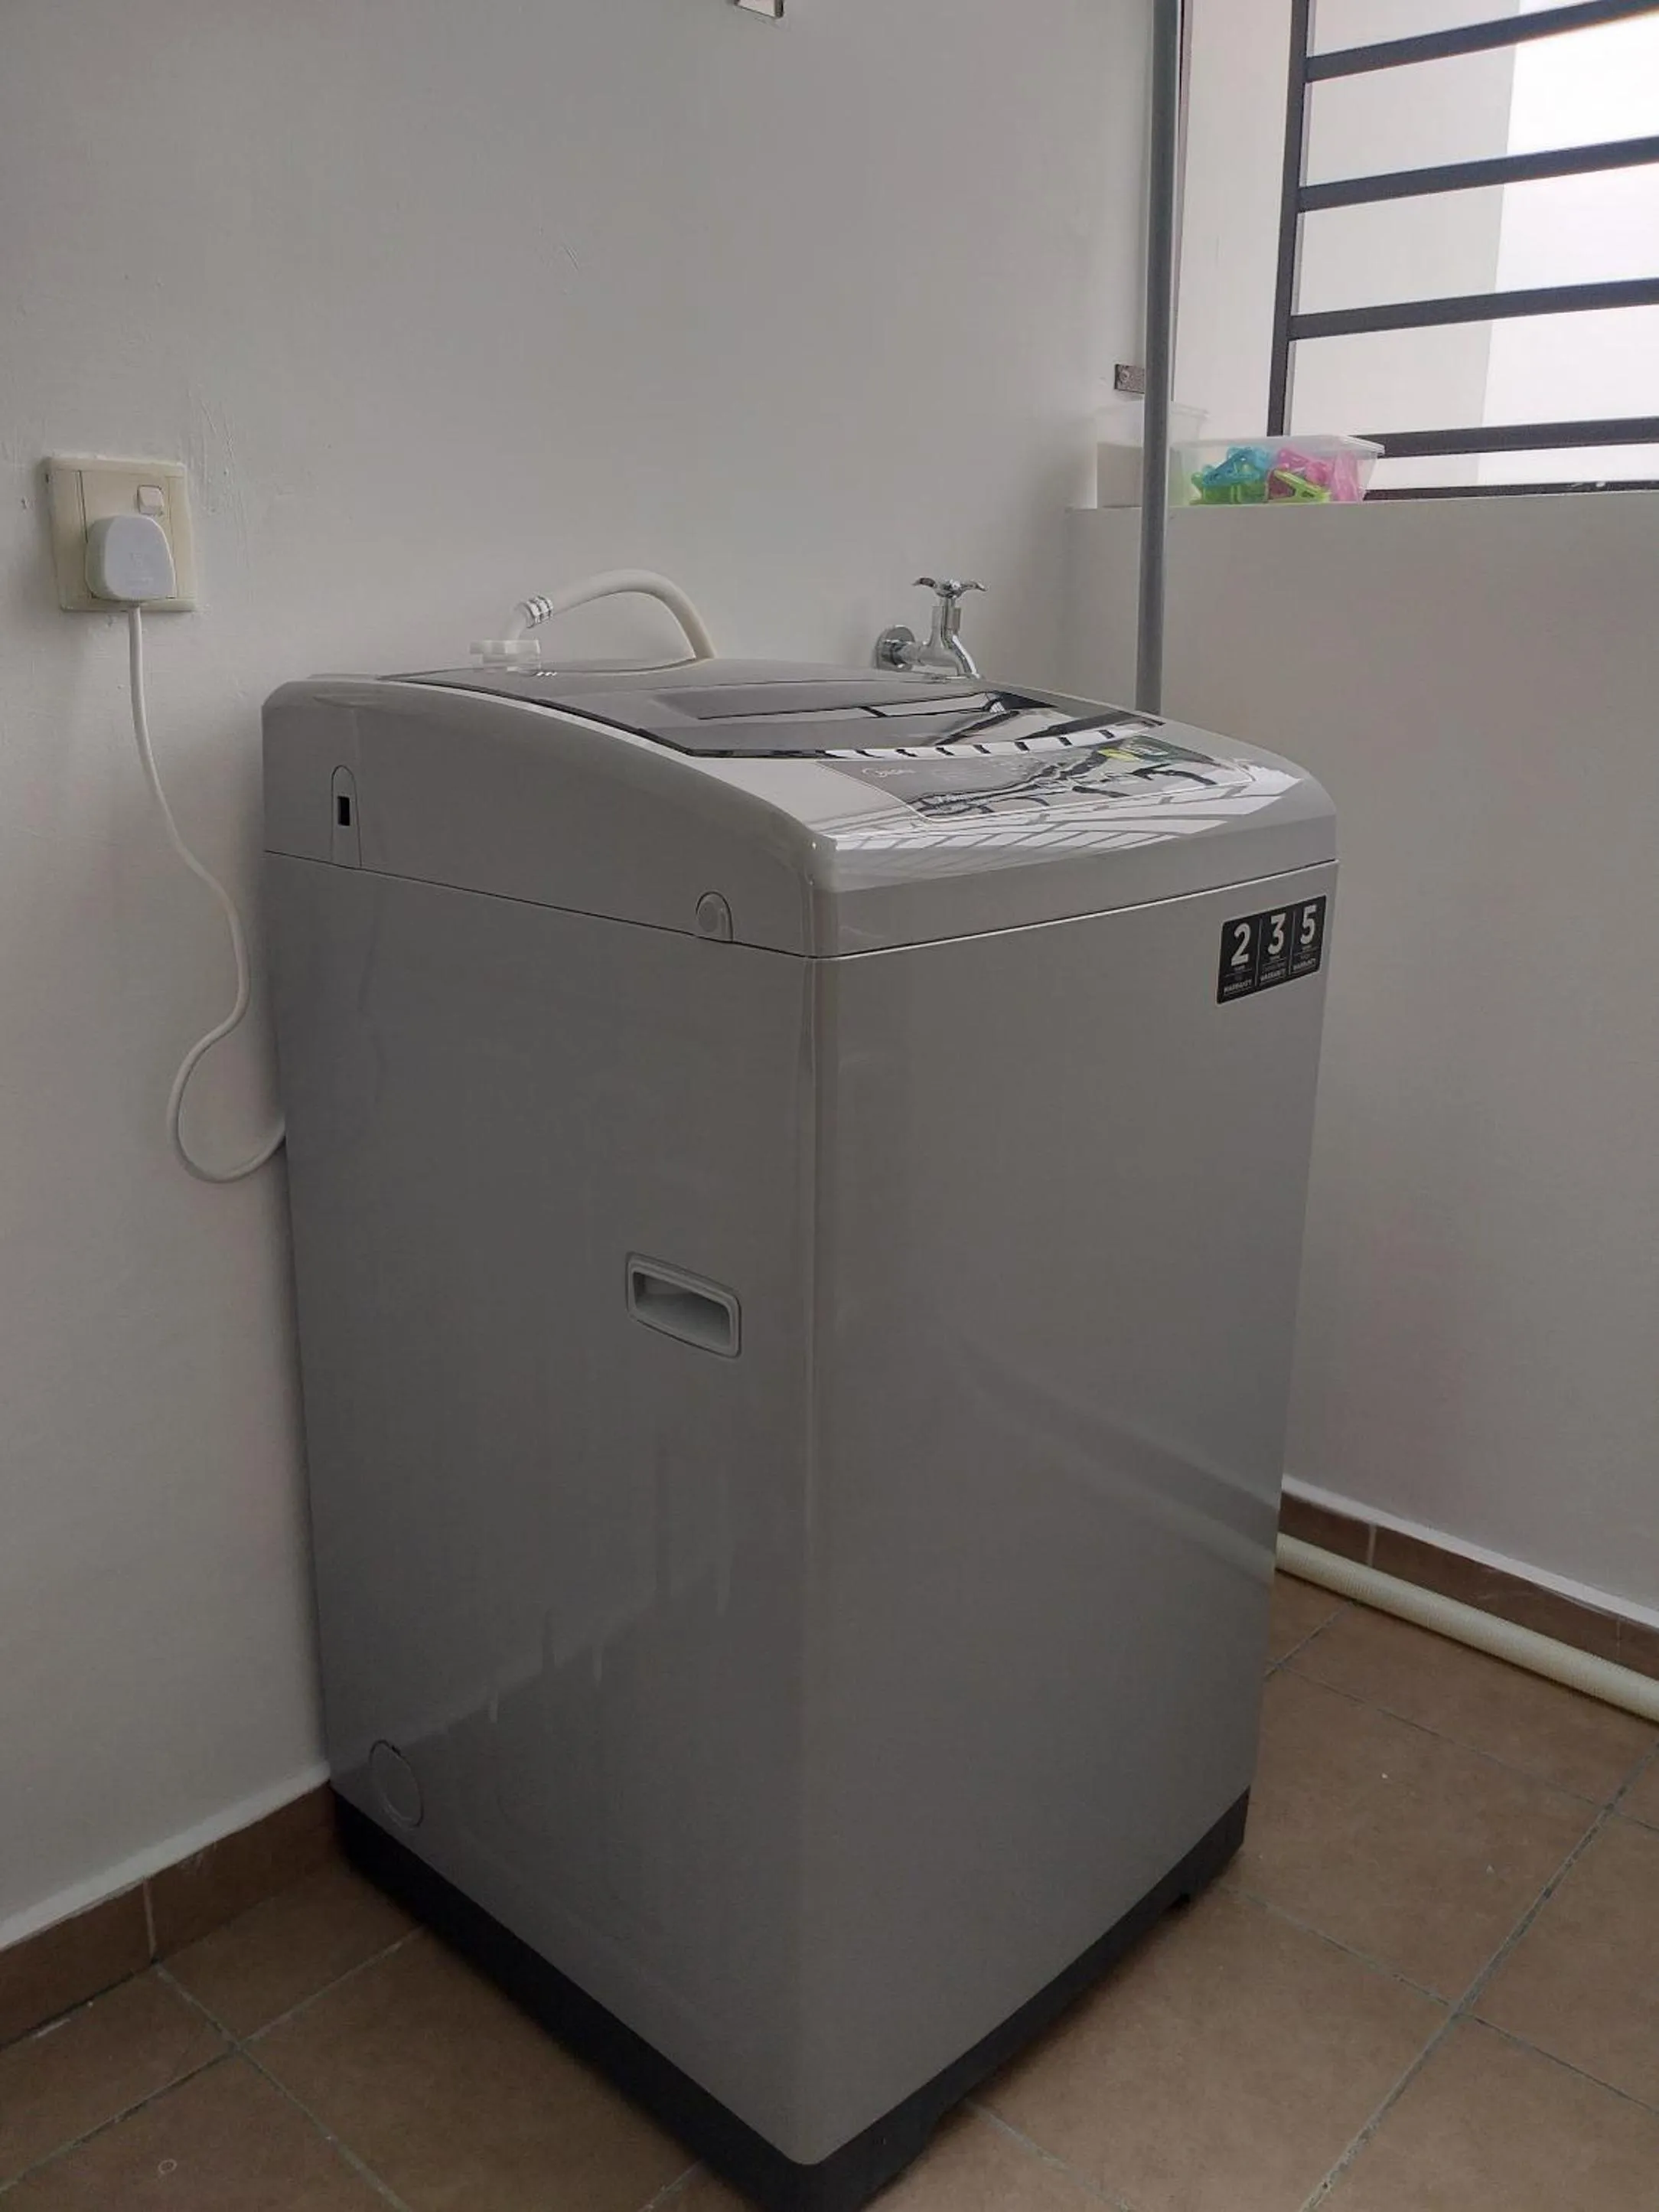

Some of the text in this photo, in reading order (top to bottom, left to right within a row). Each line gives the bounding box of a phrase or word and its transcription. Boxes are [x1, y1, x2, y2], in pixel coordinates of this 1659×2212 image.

[1230, 905, 1317, 967] 2 3 5
